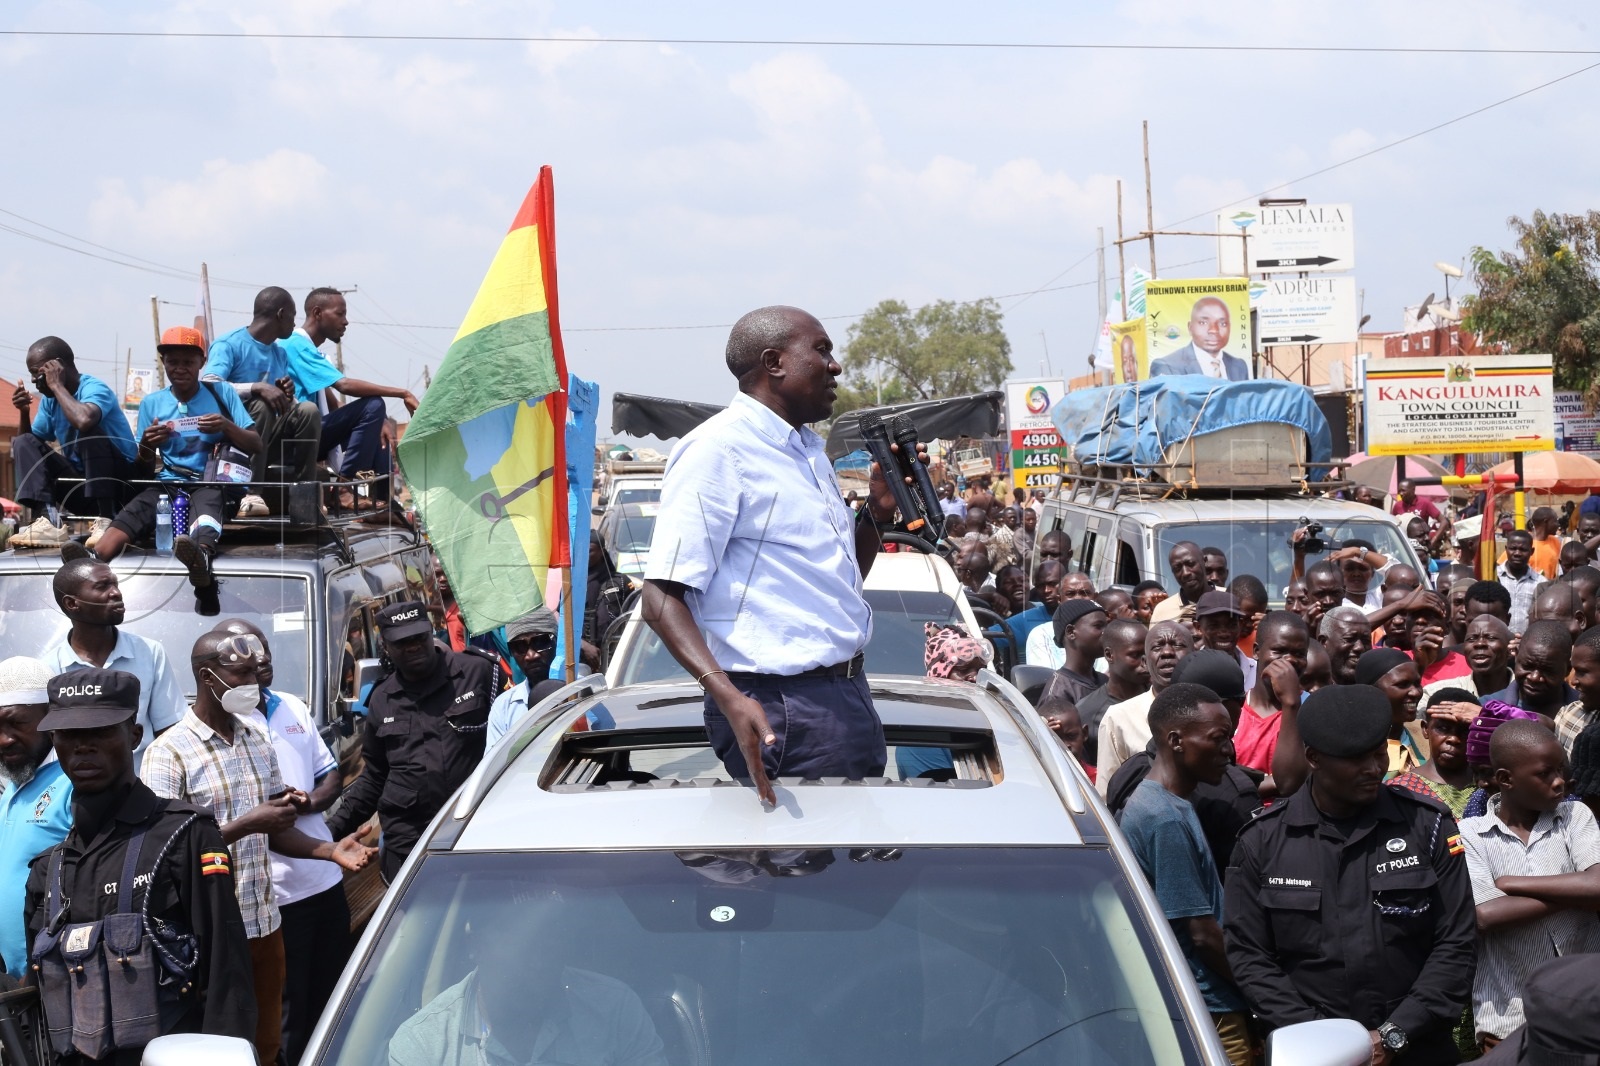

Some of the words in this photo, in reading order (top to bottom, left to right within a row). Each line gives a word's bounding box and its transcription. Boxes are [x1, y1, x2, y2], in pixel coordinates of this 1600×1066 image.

[1261, 208, 1344, 225] LEMALA
[1262, 226, 1346, 234] WILDWATERS
[1148, 286, 1186, 296] MULINDWA
[1187, 285, 1224, 294] FENEKANSI
[1226, 284, 1248, 292] BRIAN
[1271, 279, 1336, 297] ADRIFT
[1378, 384, 1542, 401] KANGULUMIRA
[1399, 402, 1446, 413] TOWN
[1451, 400, 1524, 412] COUNCIL
[1444, 412, 1515, 420] GOVERNMENT
[1023, 434, 1058, 447] 4900
[1024, 453, 1058, 467] 4450
[1026, 474, 1059, 487] 410
[391, 609, 419, 624] POLICE
[58, 684, 102, 698] POLICE
[1376, 862, 1387, 874] CT
[1390, 855, 1420, 870] POLICE
[104, 882, 118, 894] CT
[133, 872, 152, 888] PPU
[721, 910, 730, 920] 3
